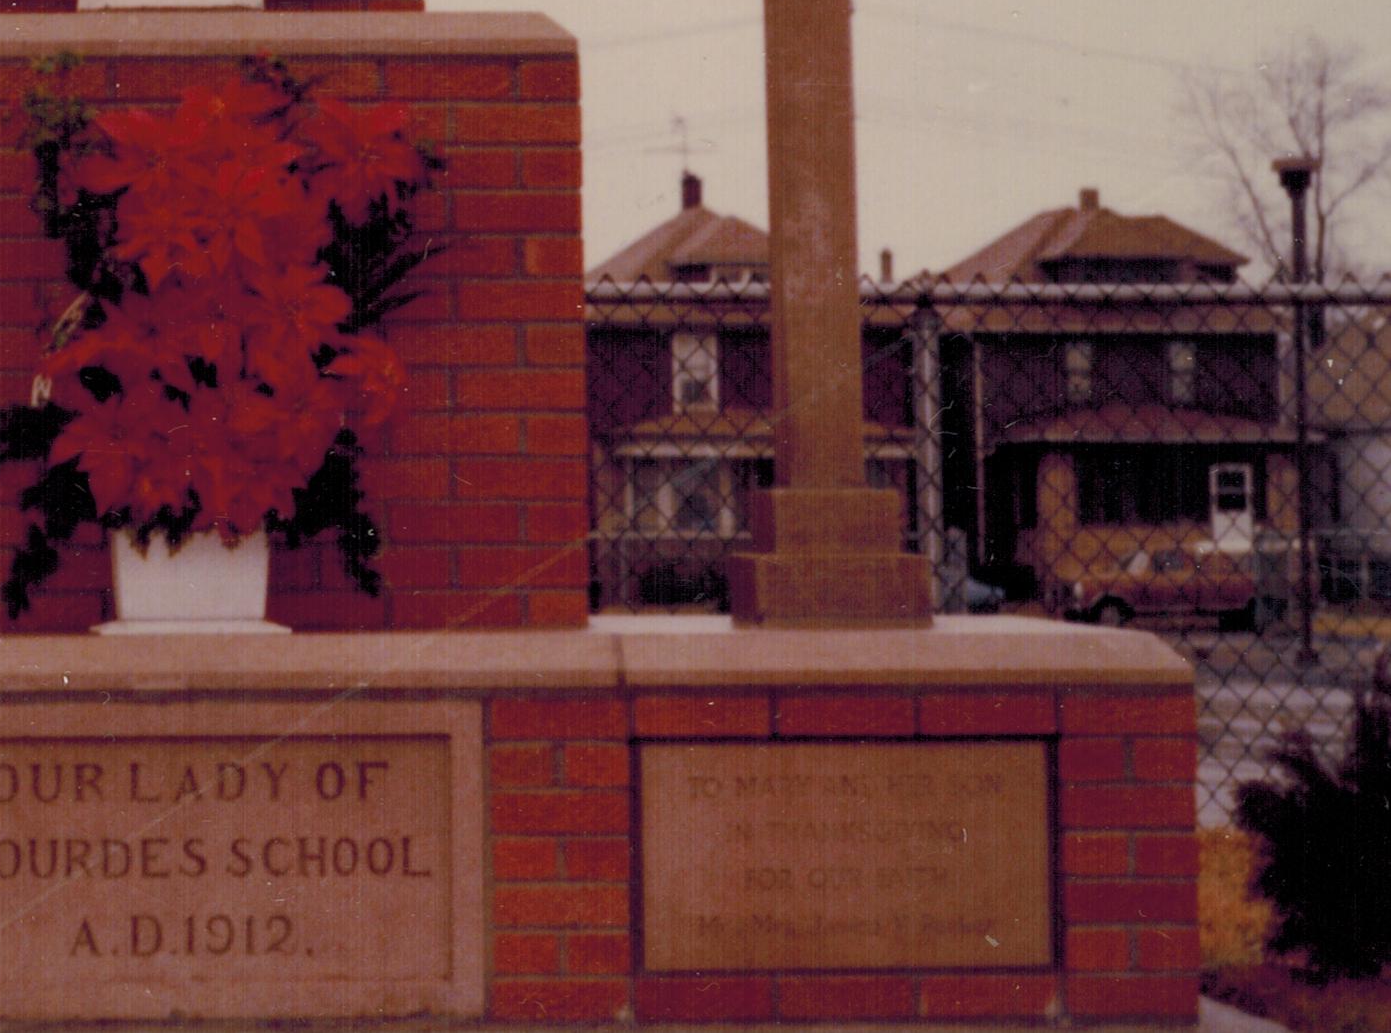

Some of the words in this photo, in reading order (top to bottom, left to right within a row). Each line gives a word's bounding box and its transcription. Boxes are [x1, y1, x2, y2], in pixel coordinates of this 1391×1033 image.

[129, 761, 289, 804] LADY
[314, 761, 391, 802] OF
[686, 775, 723, 800] TO
[225, 835, 431, 879] SCHOOL
[745, 867, 793, 891] FOR
